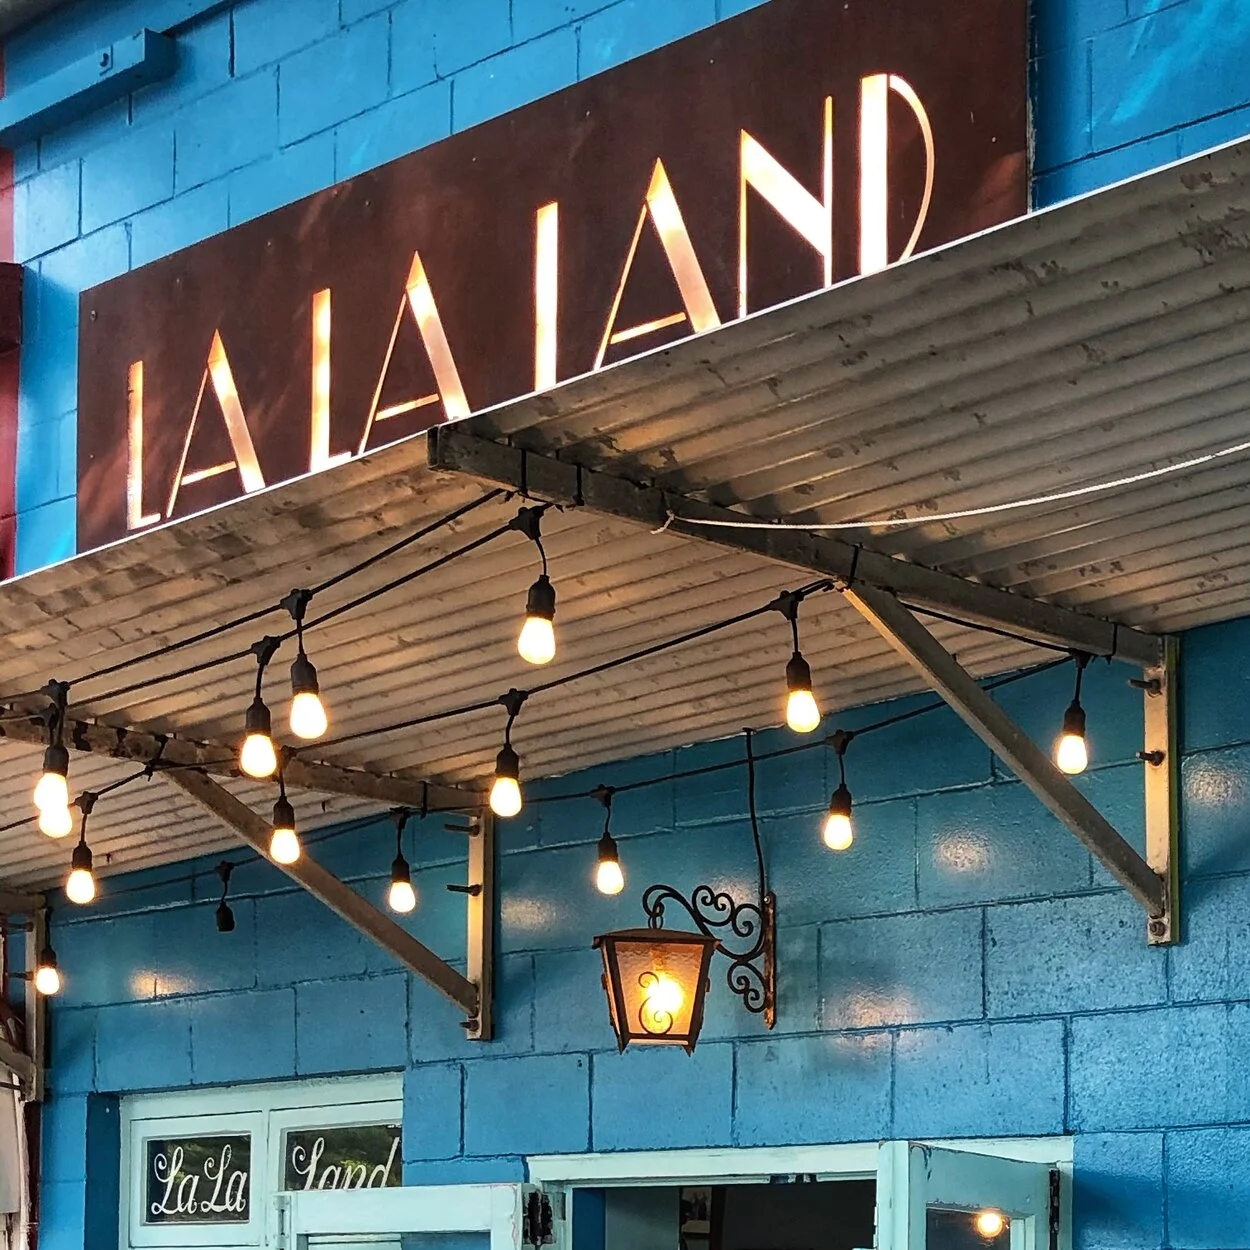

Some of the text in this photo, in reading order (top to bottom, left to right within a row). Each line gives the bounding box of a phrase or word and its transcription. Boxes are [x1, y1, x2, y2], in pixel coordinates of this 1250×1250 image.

[126, 330, 266, 531] LA
[309, 250, 472, 474] LA
[151, 1146, 200, 1215] La
[201, 1144, 248, 1213] La
